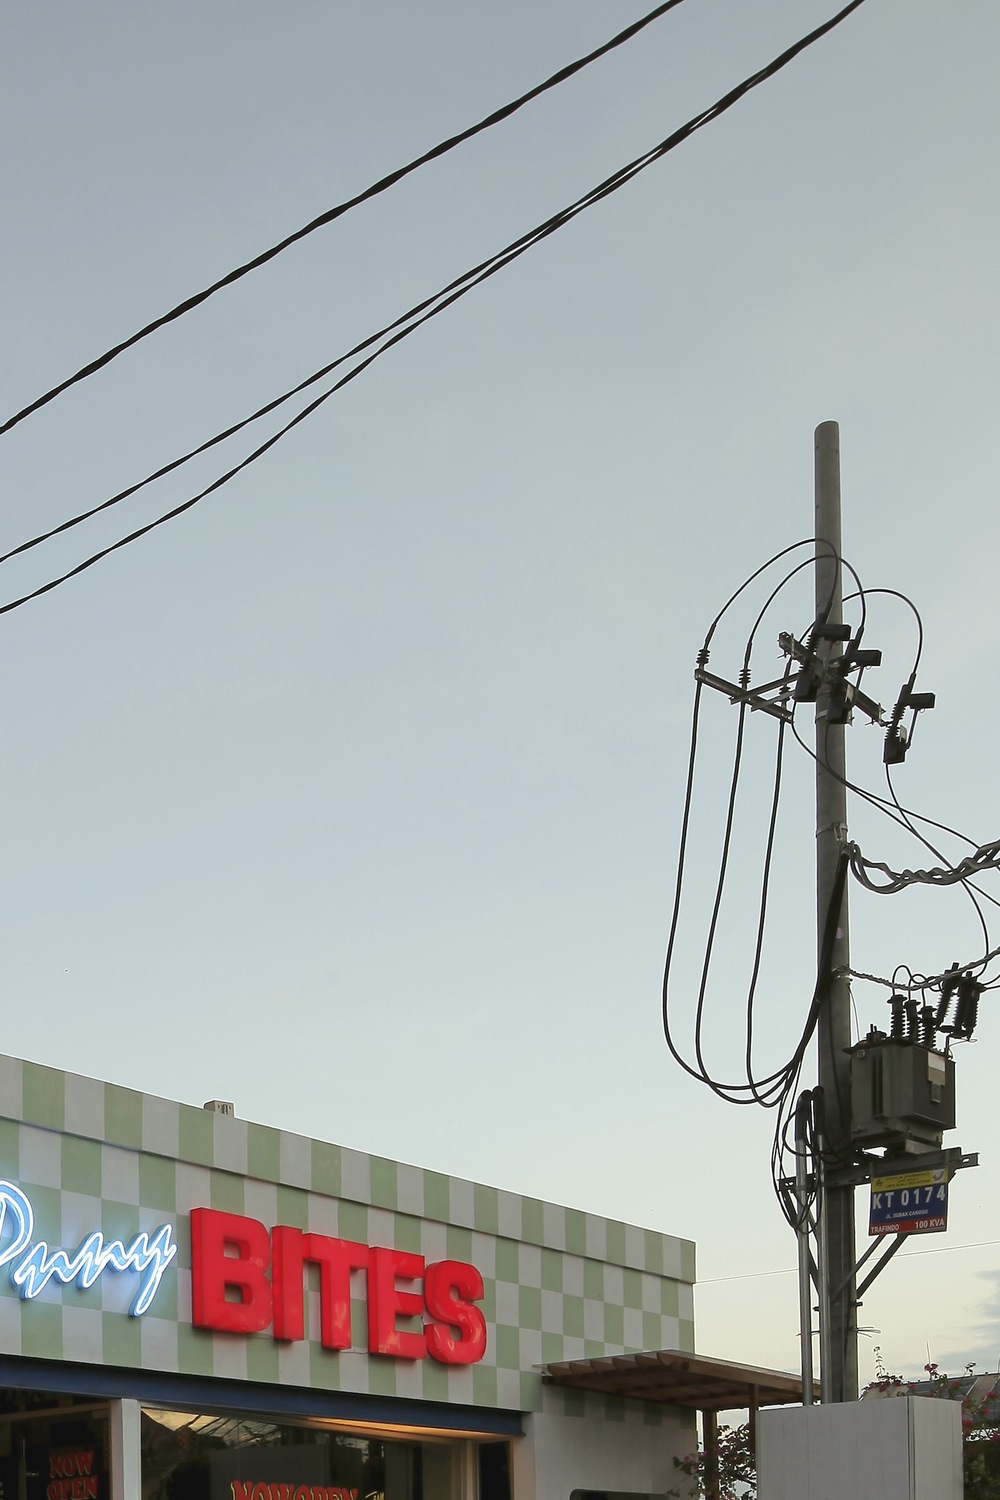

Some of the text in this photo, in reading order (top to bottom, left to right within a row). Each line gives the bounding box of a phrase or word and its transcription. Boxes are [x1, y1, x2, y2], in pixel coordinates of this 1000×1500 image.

[872, 1185, 946, 1210] KT 0174
[871, 1218, 945, 1233] TRAFINDO 100 KVA
[190, 1207, 487, 1365] BITES
[48, 1450, 95, 1479] NOW
